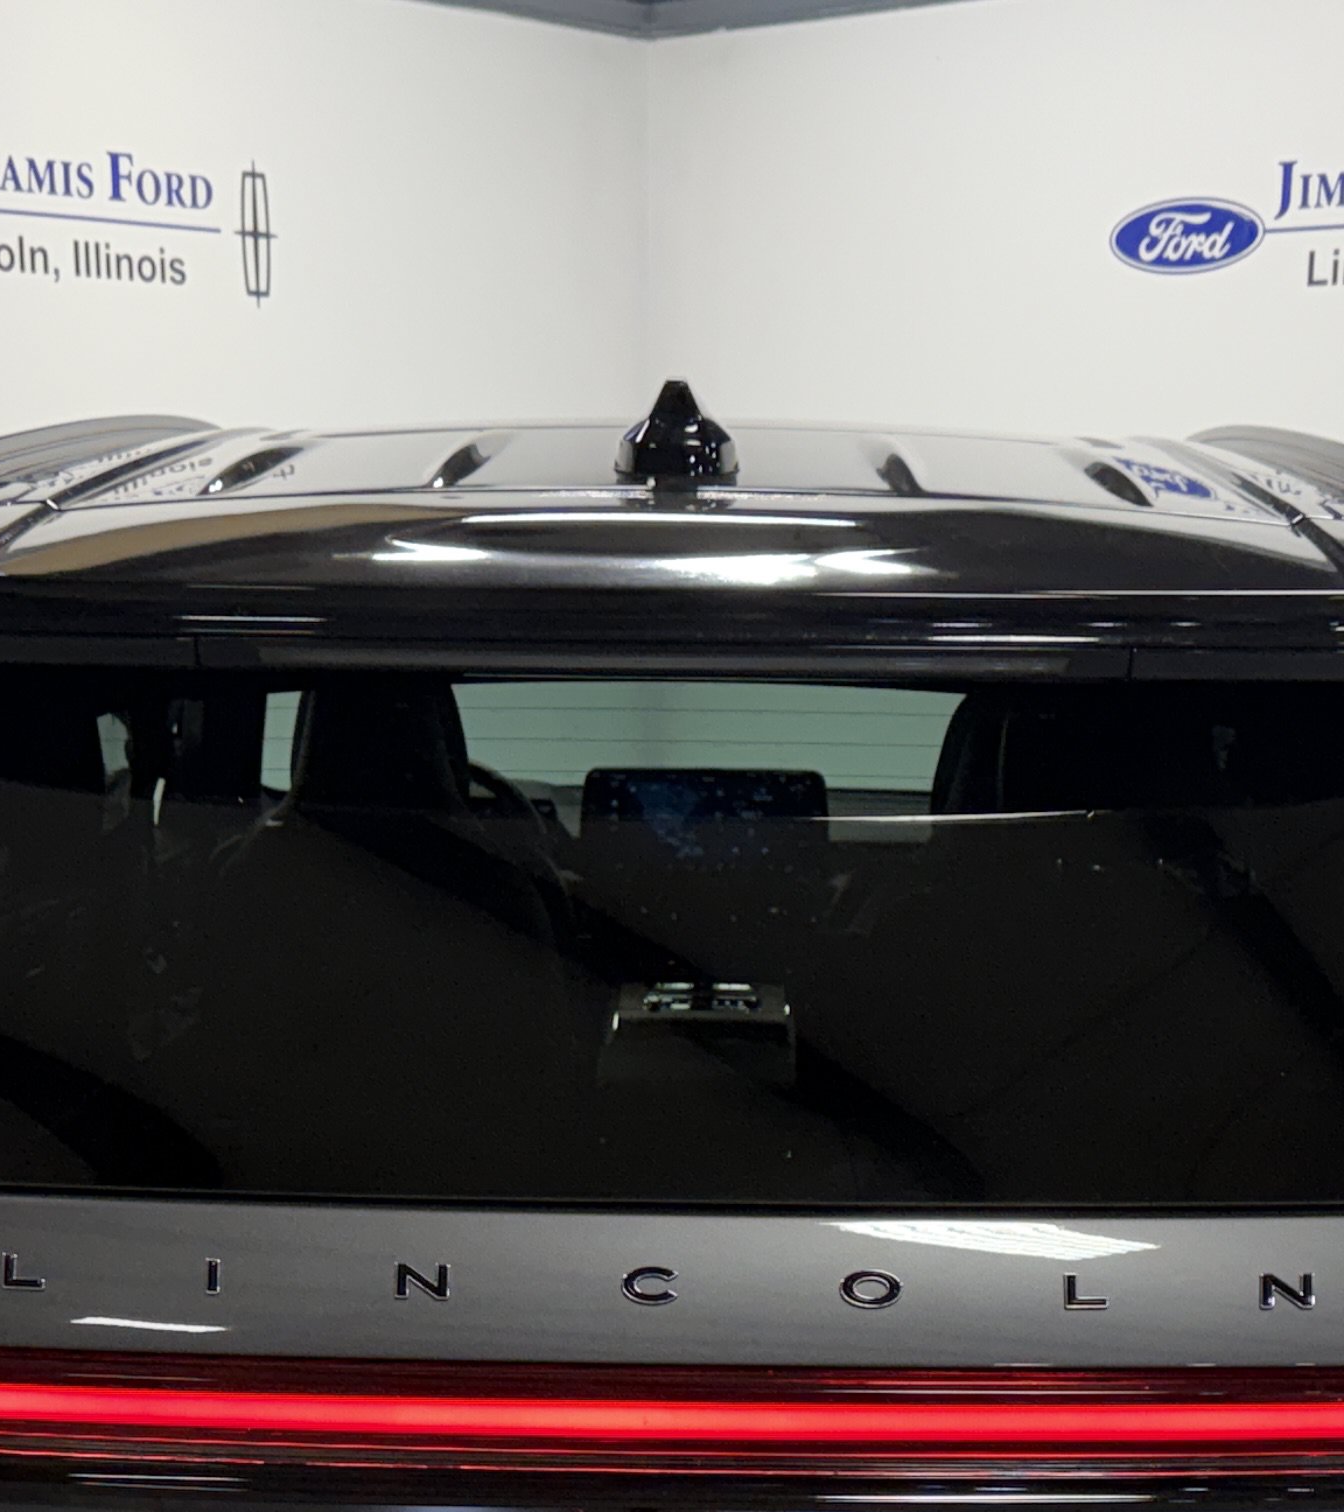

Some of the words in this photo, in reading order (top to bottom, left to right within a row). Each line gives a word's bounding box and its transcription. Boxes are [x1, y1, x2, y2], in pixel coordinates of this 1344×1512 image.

[1137, 210, 1236, 262] Ford
[74, 240, 186, 285] Illinois
[2, 1250, 1316, 1311] LINCOLN
